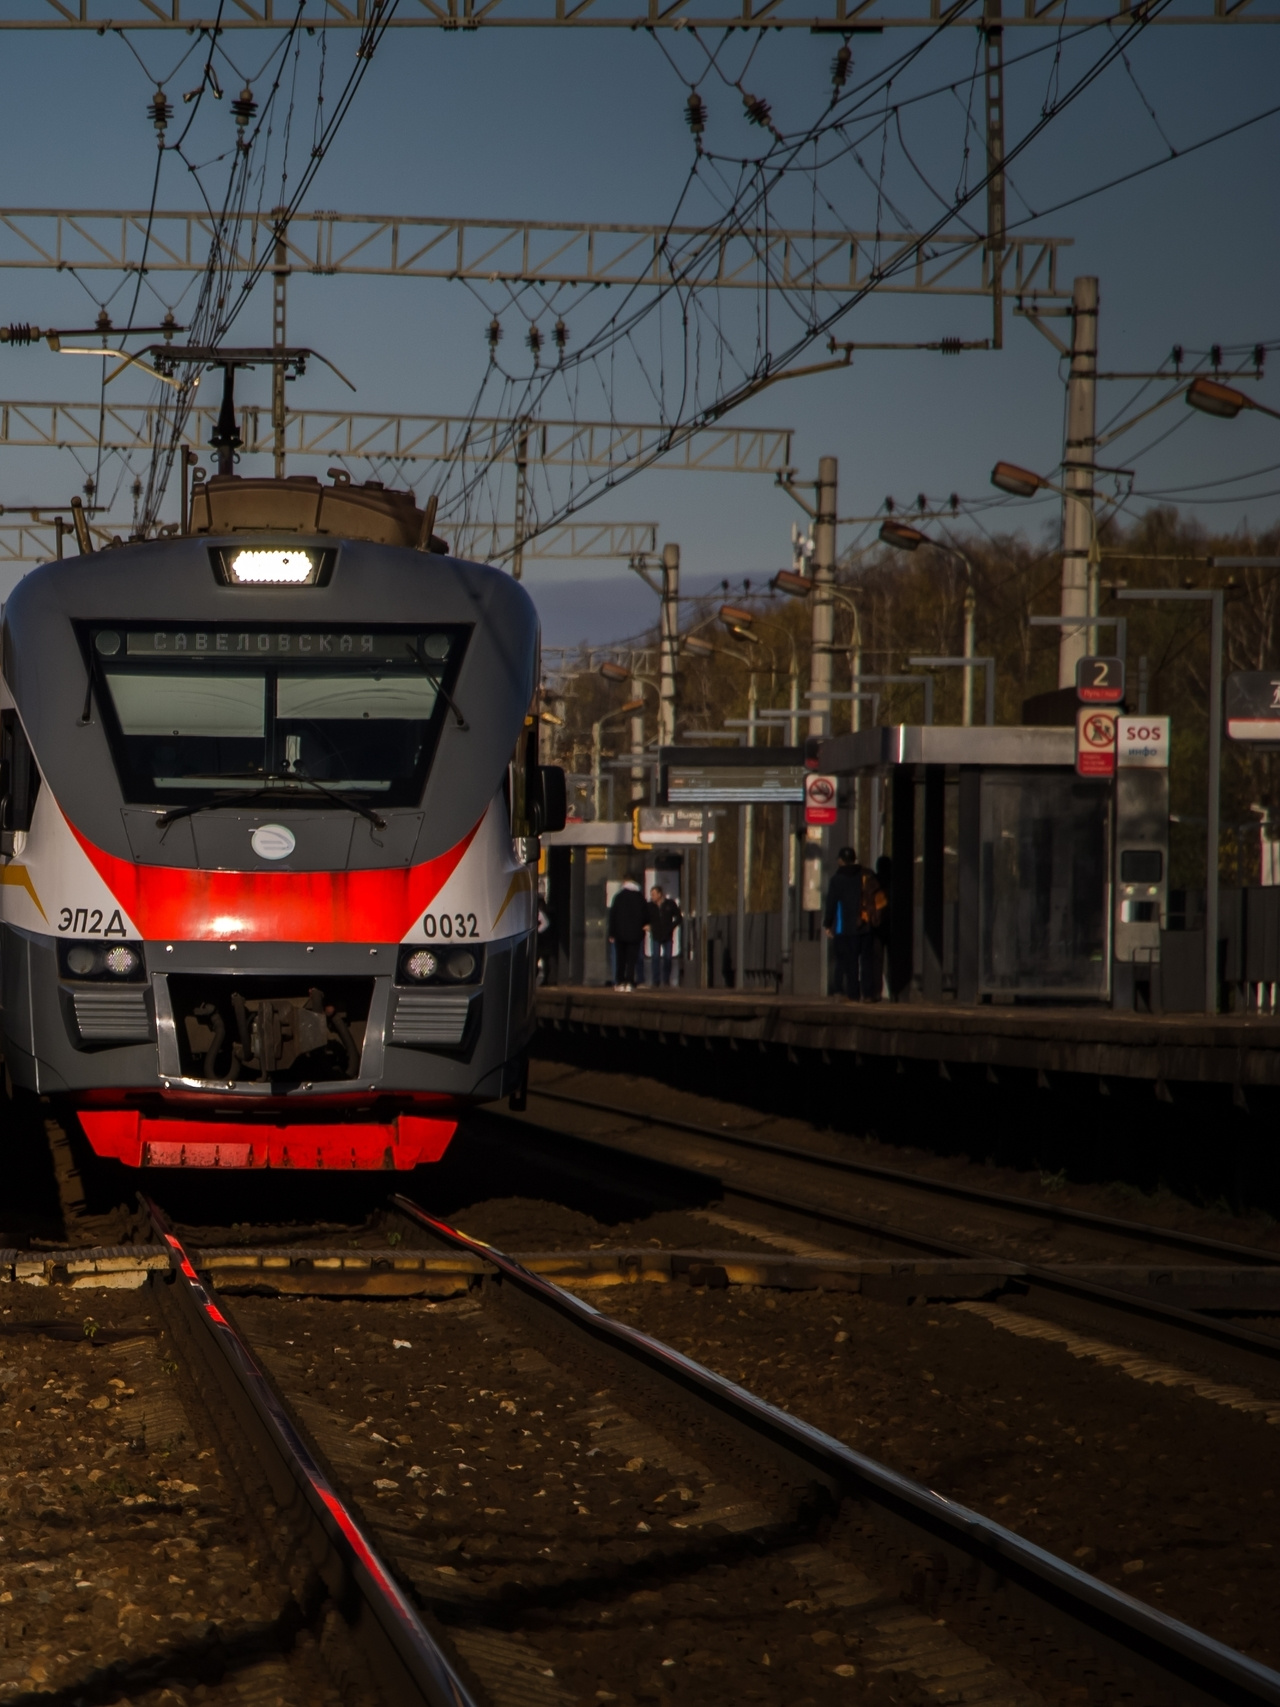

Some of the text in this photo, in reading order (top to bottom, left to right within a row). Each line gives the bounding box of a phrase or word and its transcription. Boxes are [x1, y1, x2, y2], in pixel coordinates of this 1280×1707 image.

[154, 633, 374, 652] САВЕЛОВСКАЯ
[1093, 662, 1109, 687] 2
[1127, 727, 1161, 741] SOS
[1129, 747, 1157, 758] инфо
[58, 907, 127, 937] ЭП2Д
[423, 913, 480, 938] 0032
